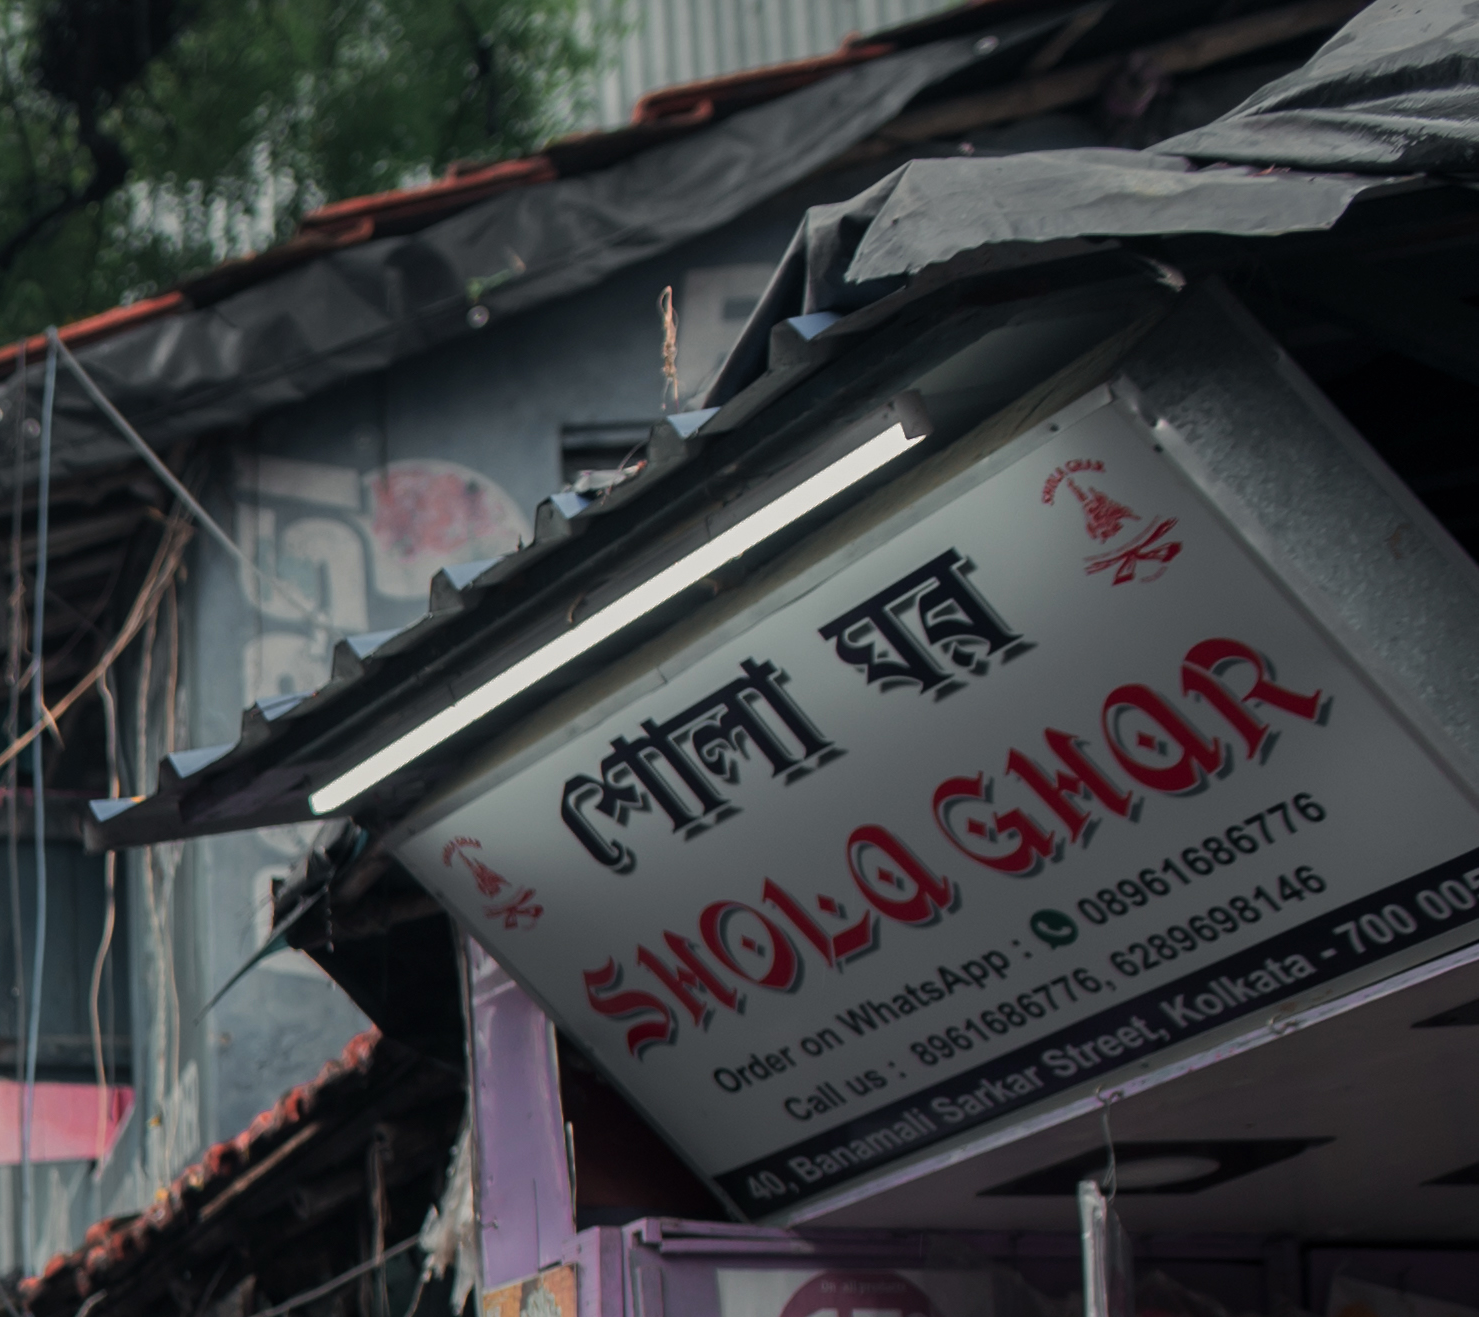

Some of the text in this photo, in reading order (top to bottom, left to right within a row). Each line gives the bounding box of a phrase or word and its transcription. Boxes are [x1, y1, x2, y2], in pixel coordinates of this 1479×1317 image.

[561, 546, 1028, 868] শোলা ঘর
[583, 638, 1325, 1058] SHOLA GHAR
[713, 1041, 796, 1094] Order
[800, 1025, 845, 1058] on
[834, 947, 1011, 1038] WhatsApp
[1076, 792, 1327, 927] 08961686776
[746, 1162, 799, 1203] 40,
[790, 1107, 936, 1183] Banamali
[931, 1065, 1044, 1123] Sarkar
[1041, 1013, 1171, 1085] Street,
[1159, 953, 1317, 1028] Kolkata
[1332, 904, 1417, 954] 700
[783, 1084, 848, 1123] Call
[850, 1065, 887, 1097] us
[910, 966, 1116, 1067] 8961686776,
[1111, 866, 1327, 979] 6289698146
